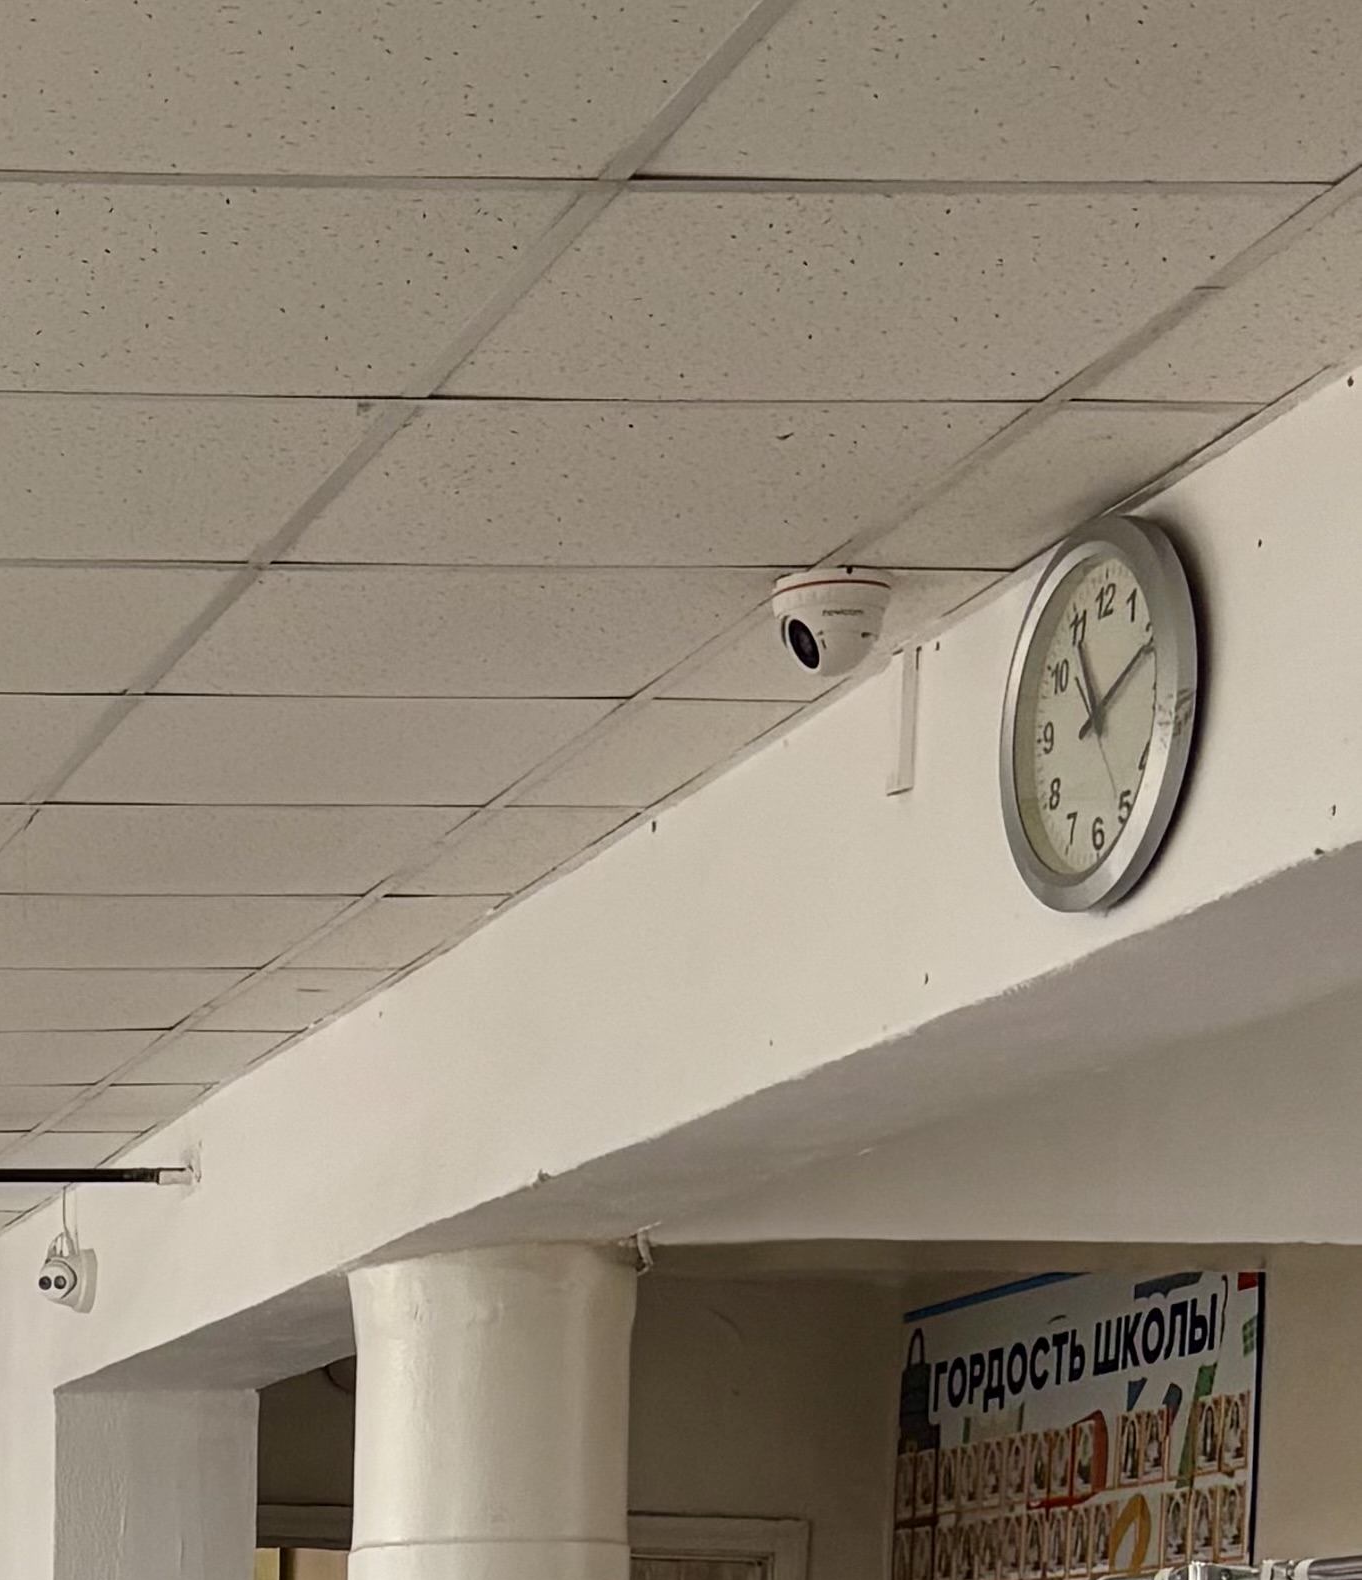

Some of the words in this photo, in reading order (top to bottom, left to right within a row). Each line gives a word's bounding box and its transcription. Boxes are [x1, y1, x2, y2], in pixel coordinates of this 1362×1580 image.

[1095, 582, 1116, 620] 12
[1126, 587, 1138, 622] 1
[1069, 609, 1088, 646] 11
[1050, 658, 1070, 695] 10
[1042, 721, 1054, 755] 9
[1048, 778, 1061, 811] 8
[1117, 789, 1131, 824] 5
[1066, 811, 1078, 846] 7
[1091, 816, 1105, 851] 6
[932, 1329, 1085, 1414] ГОРДОСТЬ
[1092, 1292, 1217, 1376] ШКОЛЫ
